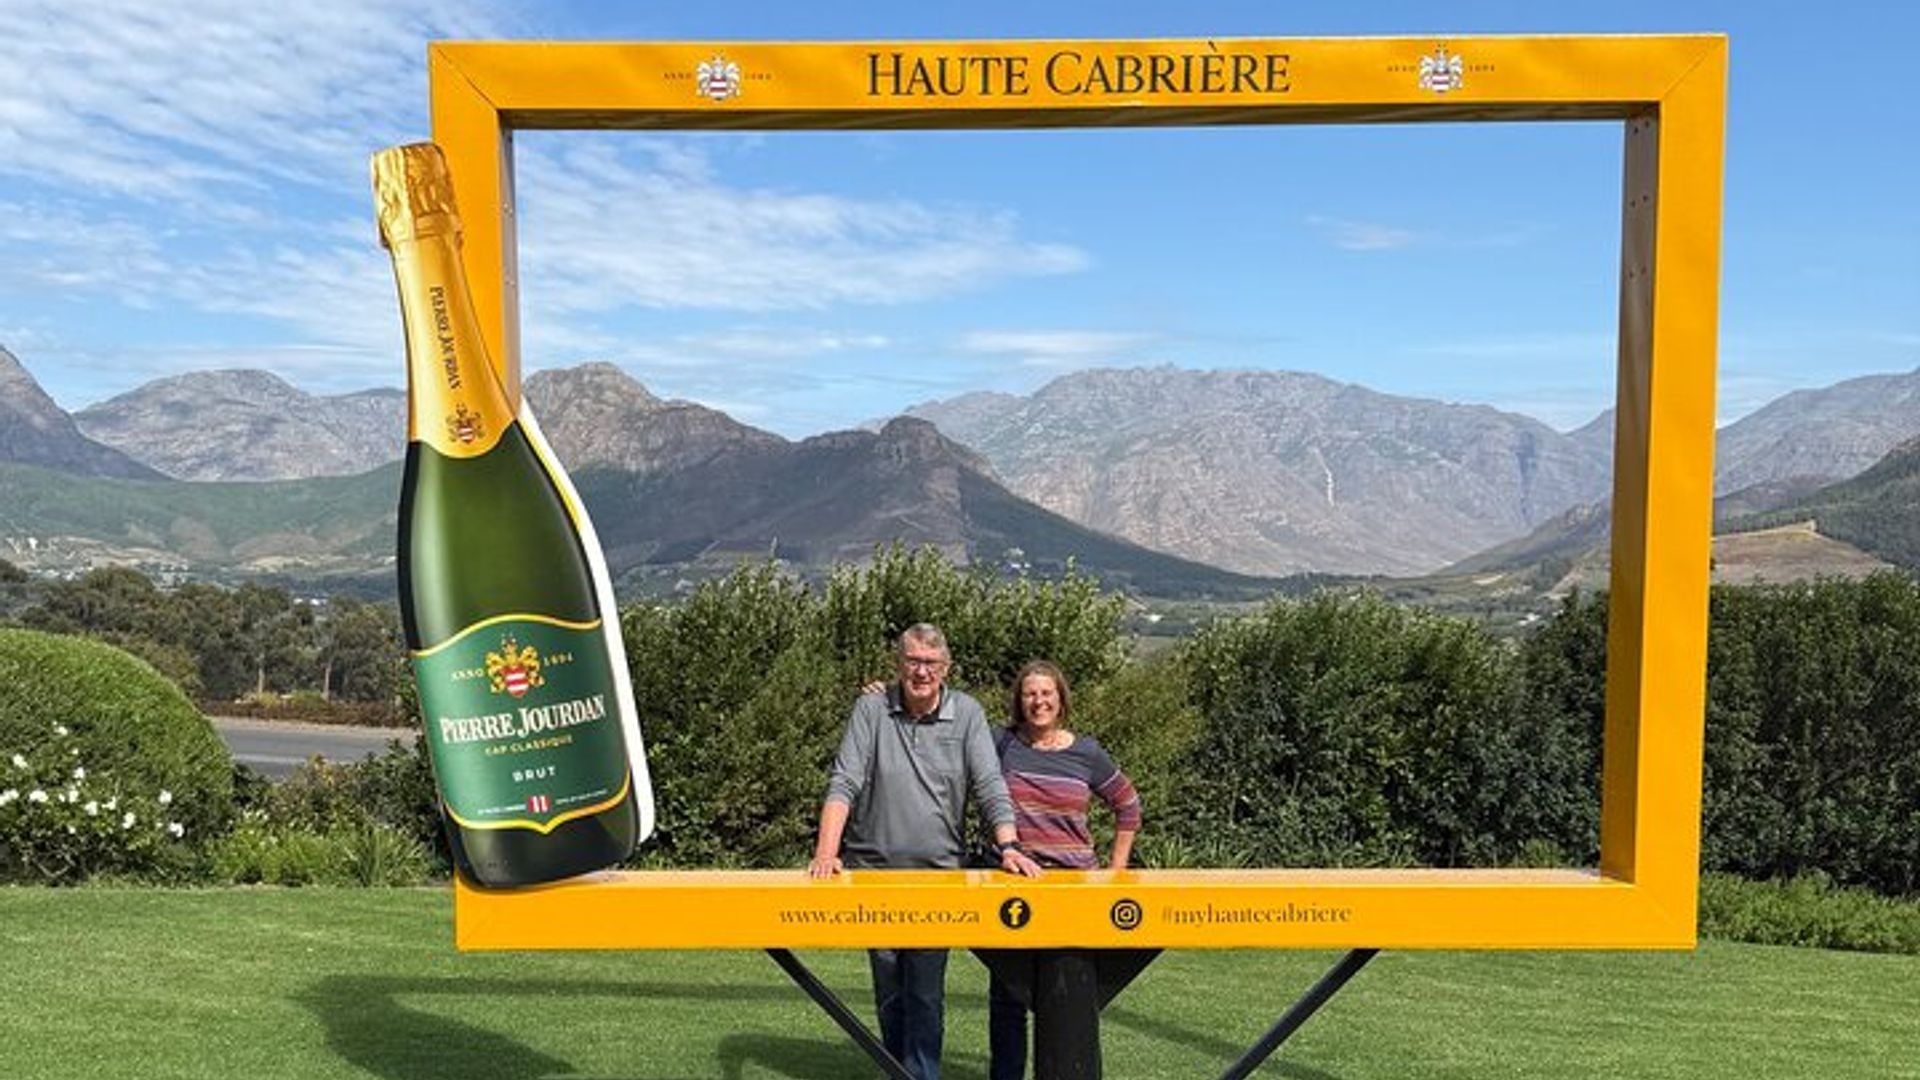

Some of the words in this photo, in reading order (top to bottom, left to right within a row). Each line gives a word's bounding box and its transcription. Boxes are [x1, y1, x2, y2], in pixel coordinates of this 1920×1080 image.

[867, 52, 1030, 97] HAUTE
[1044, 41, 1291, 96] CABRIÈRE
[441, 714, 516, 744] PIERRE
[517, 694, 606, 737] JOURDAN
[510, 735, 573, 752] CLASSIQUE
[513, 766, 556, 782] BRUT
[779, 903, 981, 925] www.cabriere.co.za
[1162, 902, 1352, 928] #myhautecabriere
